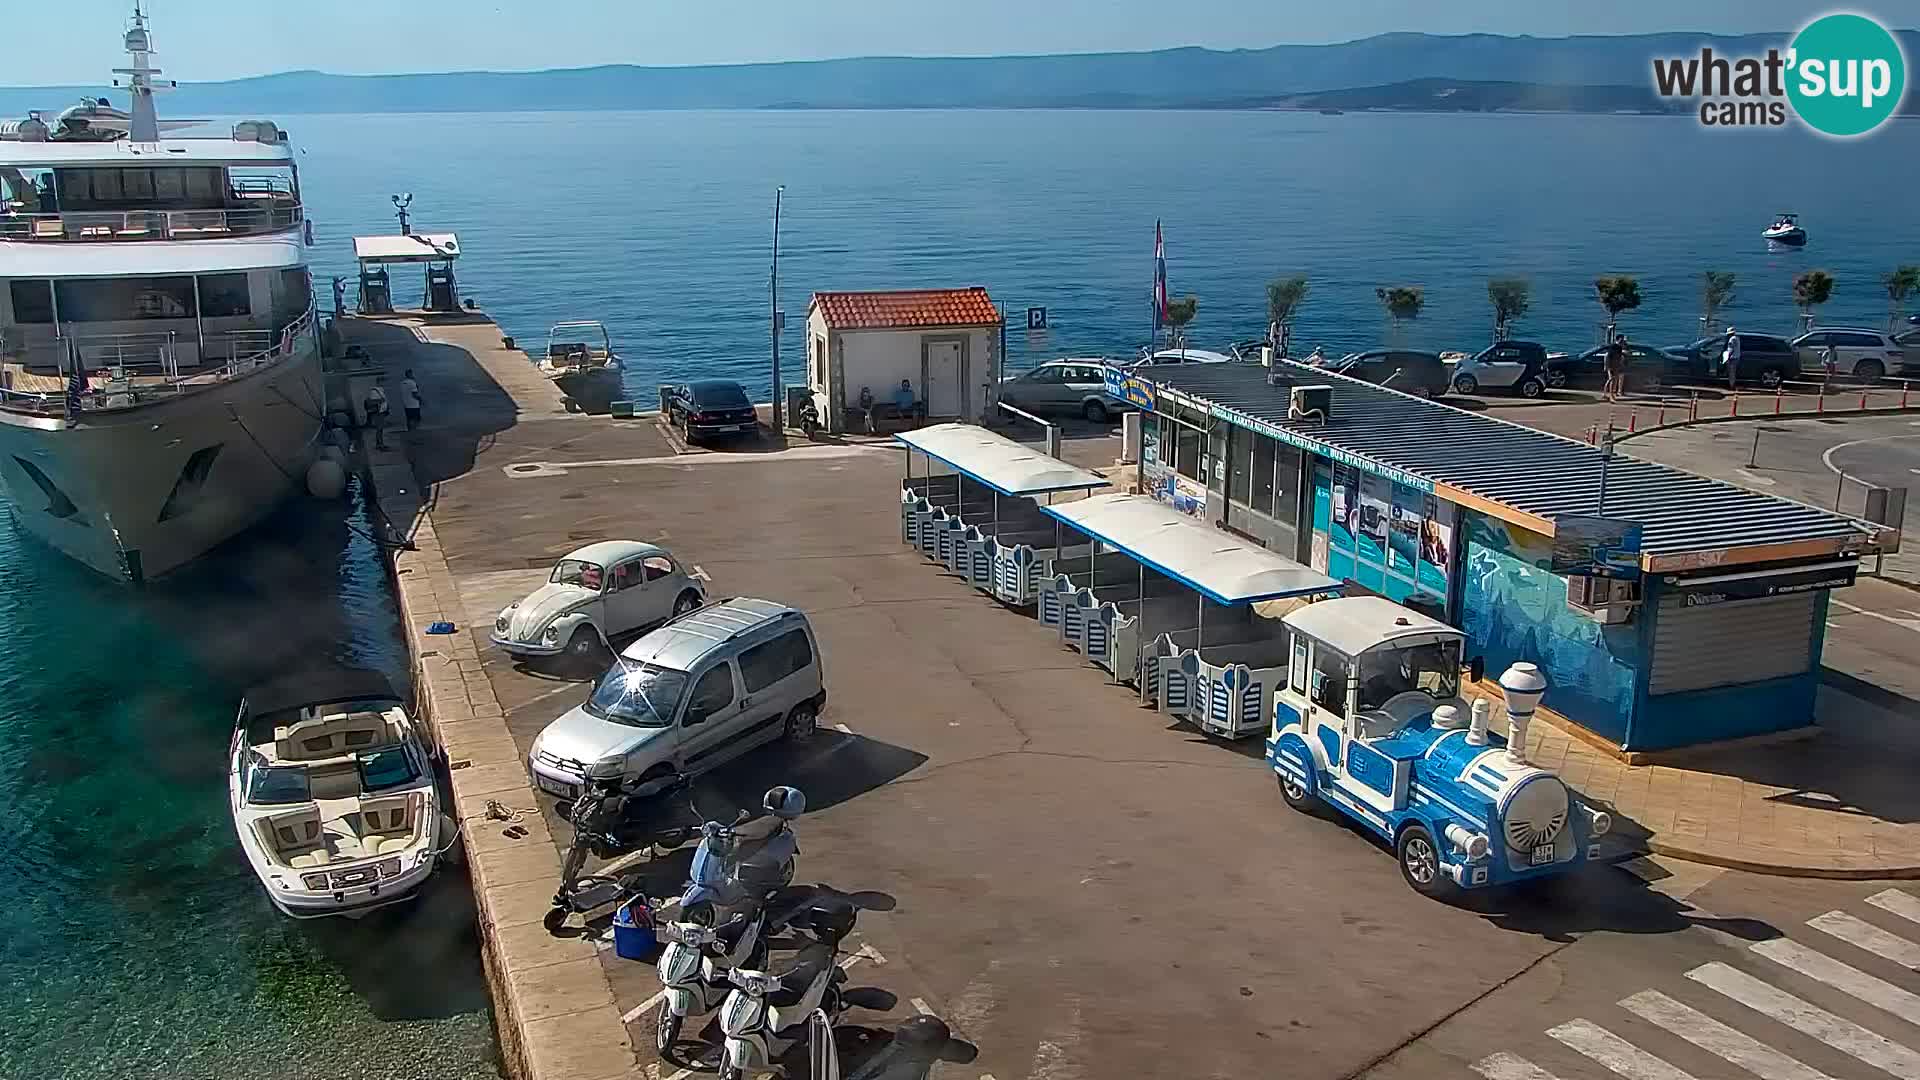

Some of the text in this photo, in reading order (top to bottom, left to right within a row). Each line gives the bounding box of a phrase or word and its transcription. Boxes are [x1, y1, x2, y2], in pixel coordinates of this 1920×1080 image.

[1032, 310, 1041, 327] P
[1291, 436, 1320, 451] POSTAJA
[1330, 449, 1343, 462] BUS
[1345, 455, 1375, 472] STATION
[1378, 465, 1401, 481] TICKET
[1403, 475, 1430, 490] OFFICE
